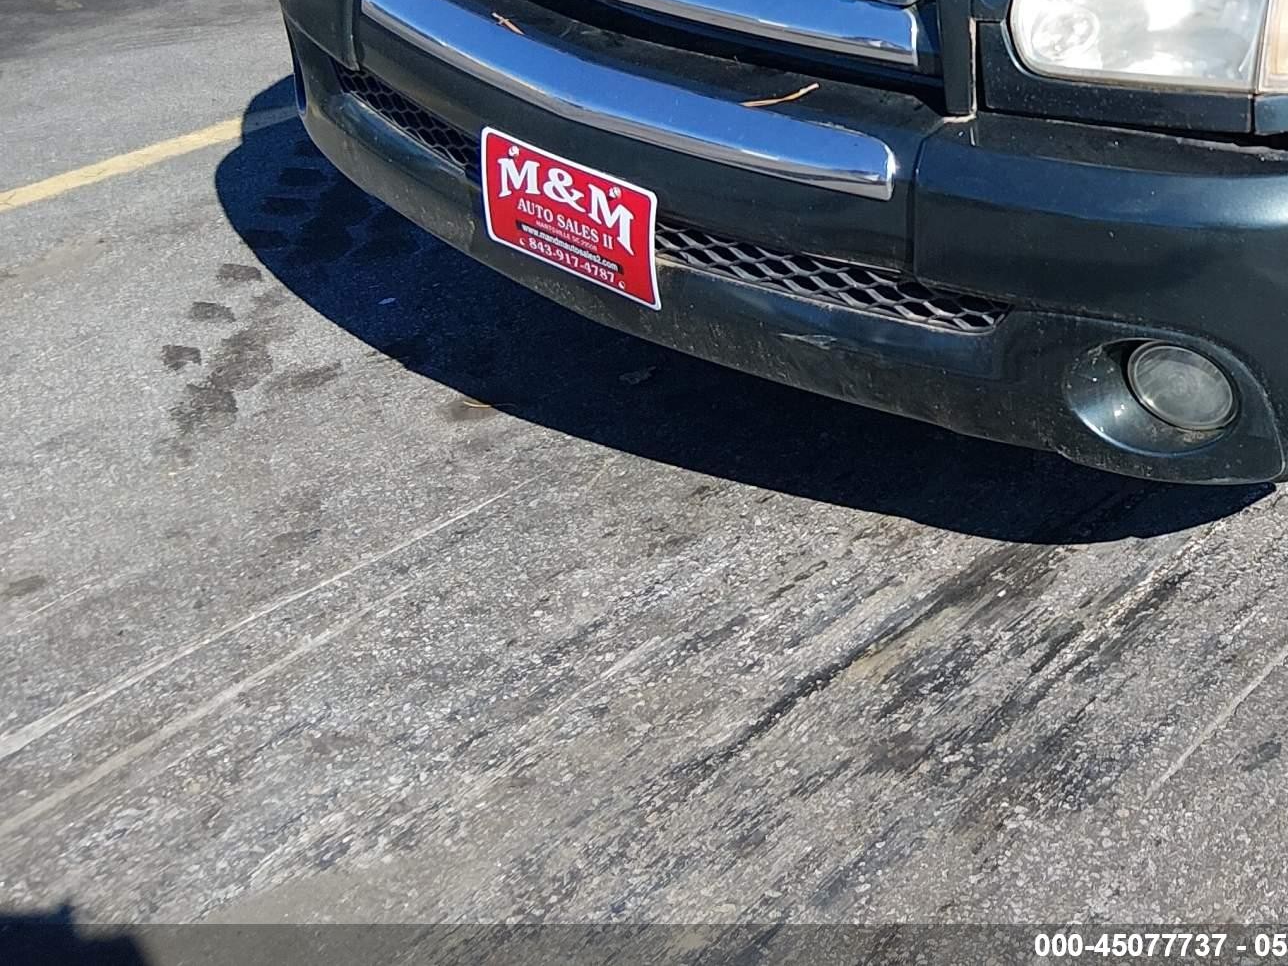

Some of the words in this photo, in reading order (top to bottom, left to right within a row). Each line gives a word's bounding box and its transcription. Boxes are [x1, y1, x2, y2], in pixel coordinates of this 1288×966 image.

[497, 157, 635, 256] M&M
[517, 198, 554, 223] AUTO
[557, 214, 599, 244] SALES
[603, 233, 614, 250] II
[528, 237, 615, 284] 843-917-4787
